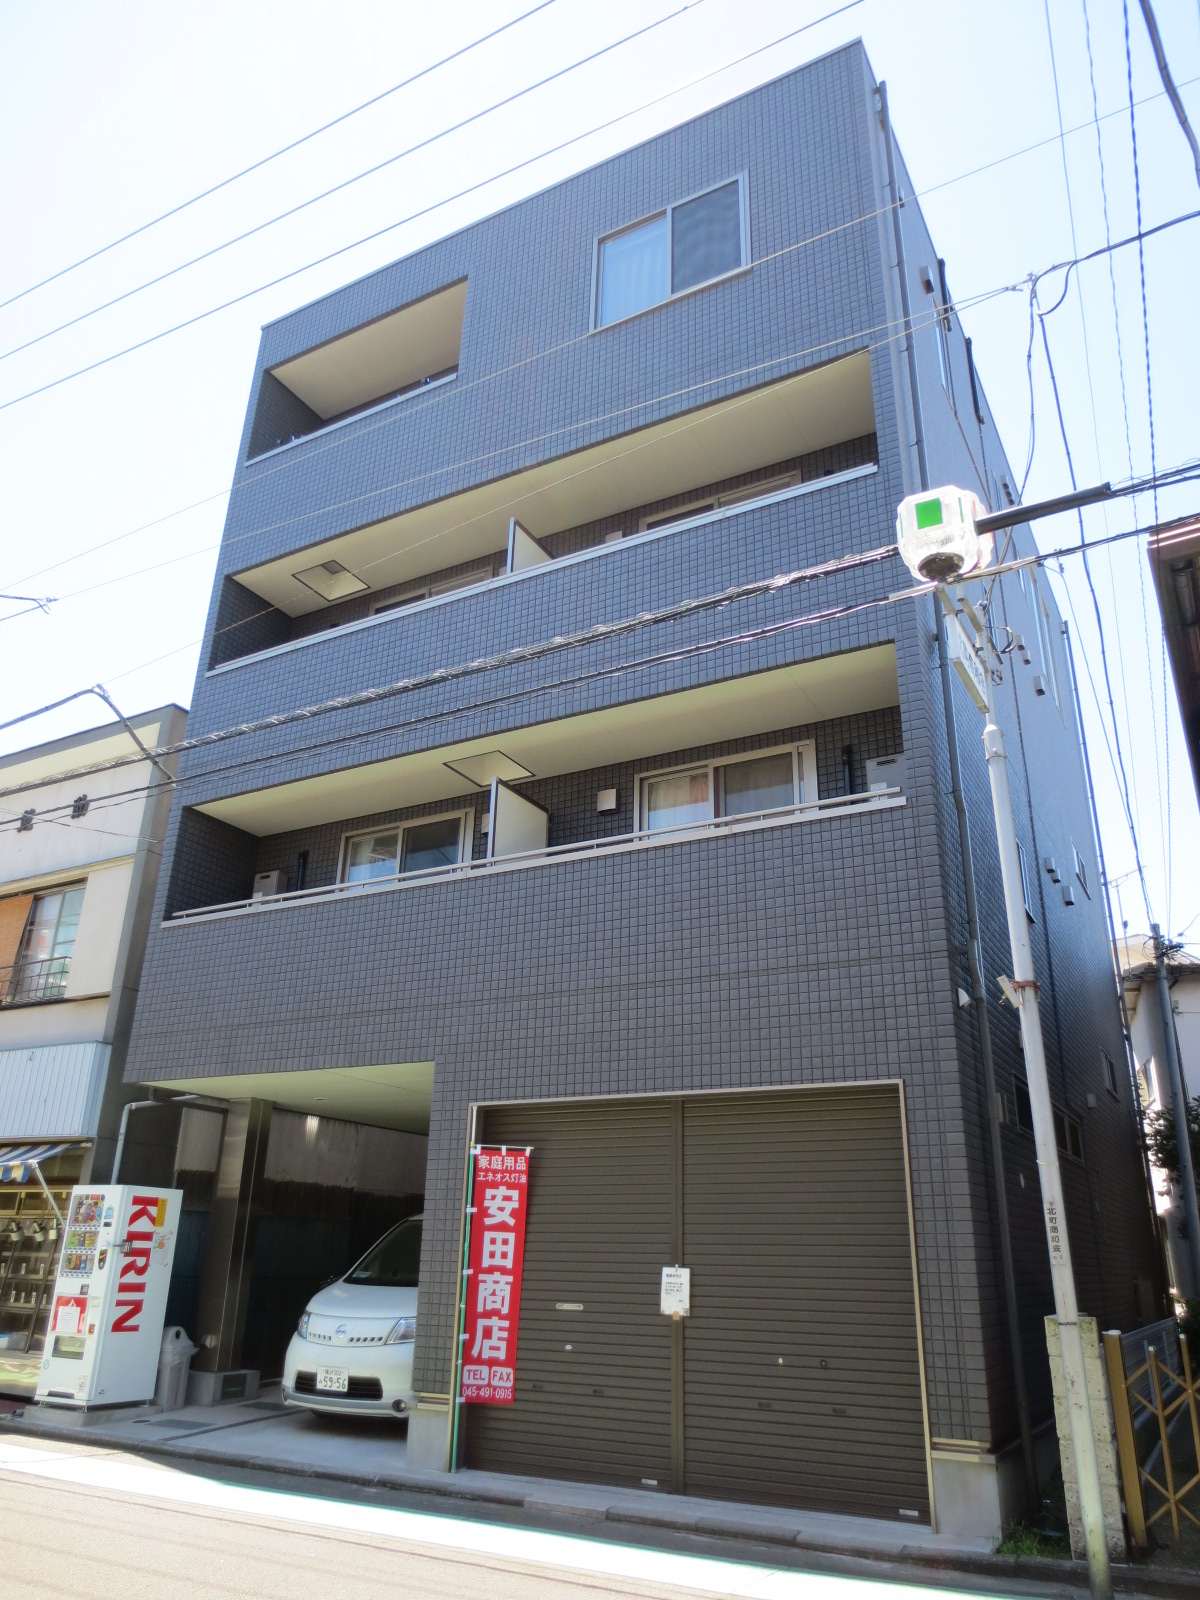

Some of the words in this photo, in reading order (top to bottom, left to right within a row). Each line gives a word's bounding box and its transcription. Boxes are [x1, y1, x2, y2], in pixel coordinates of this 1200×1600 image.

[478, 1155, 526, 1171] 家庭用品
[477, 1171, 527, 1183] エネオス灯油
[111, 1194, 159, 1333] KIRIN
[471, 1185, 519, 1361] 安田商店
[466, 1369, 485, 1381] TEL
[492, 1370, 512, 1383] FAX
[462, 1386, 512, 1399] 045-491-0915
